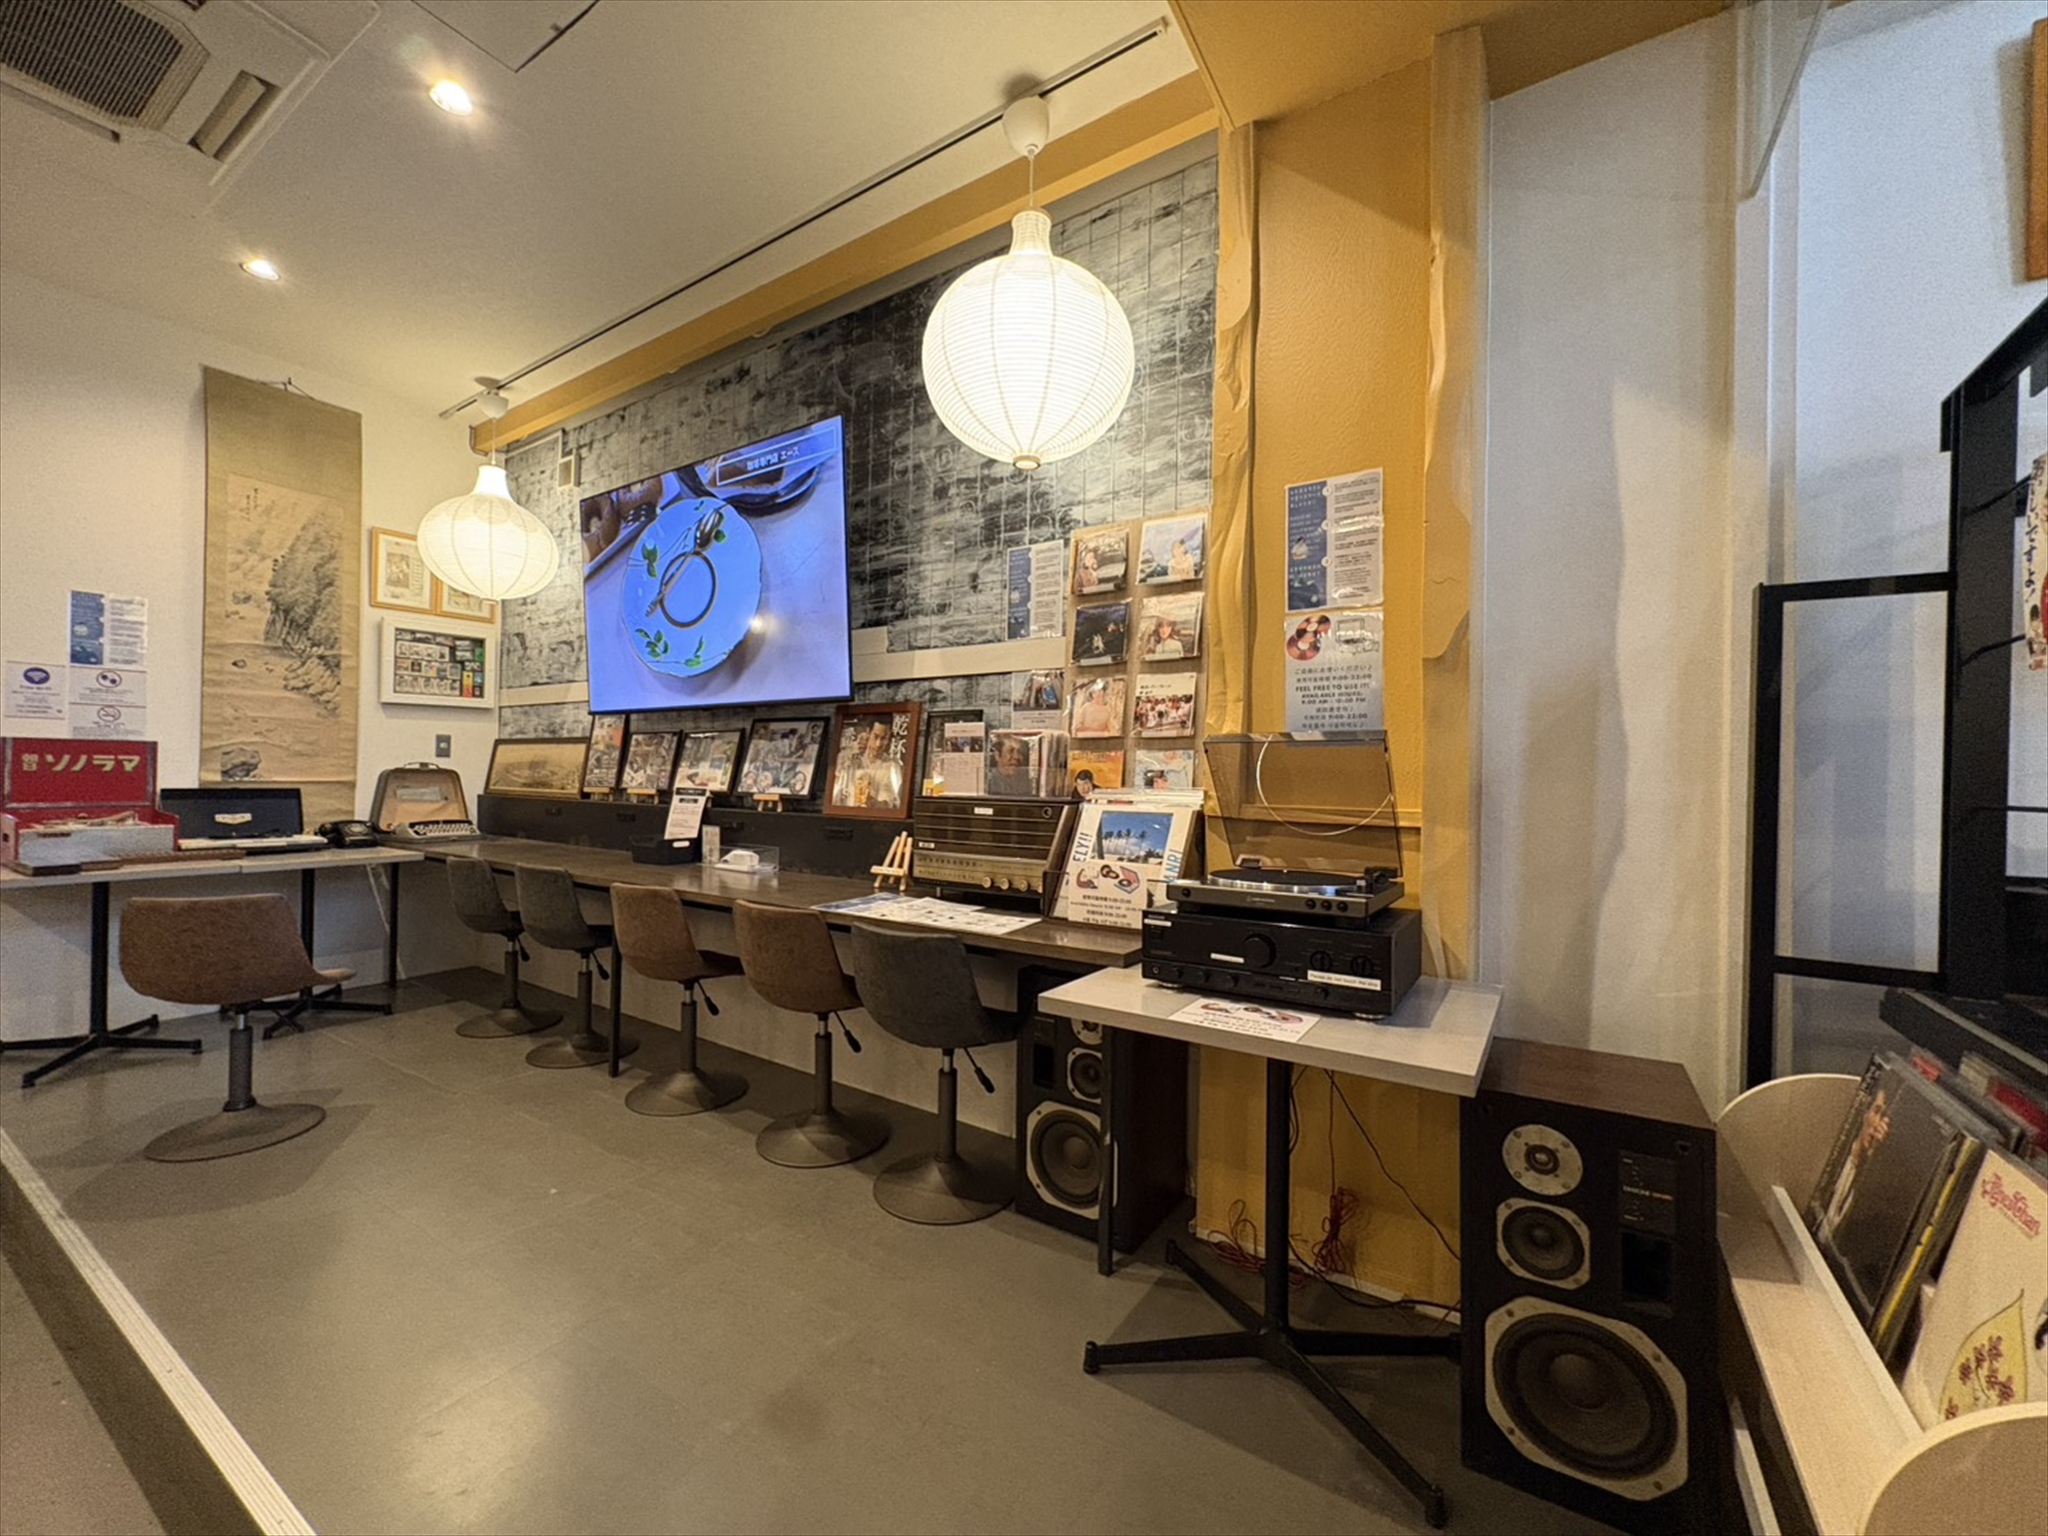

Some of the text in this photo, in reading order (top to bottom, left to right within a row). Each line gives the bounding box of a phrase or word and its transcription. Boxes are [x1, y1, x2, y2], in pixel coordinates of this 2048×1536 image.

[780, 446, 800, 460] エース
[1073, 832, 1093, 863] ELY!!
